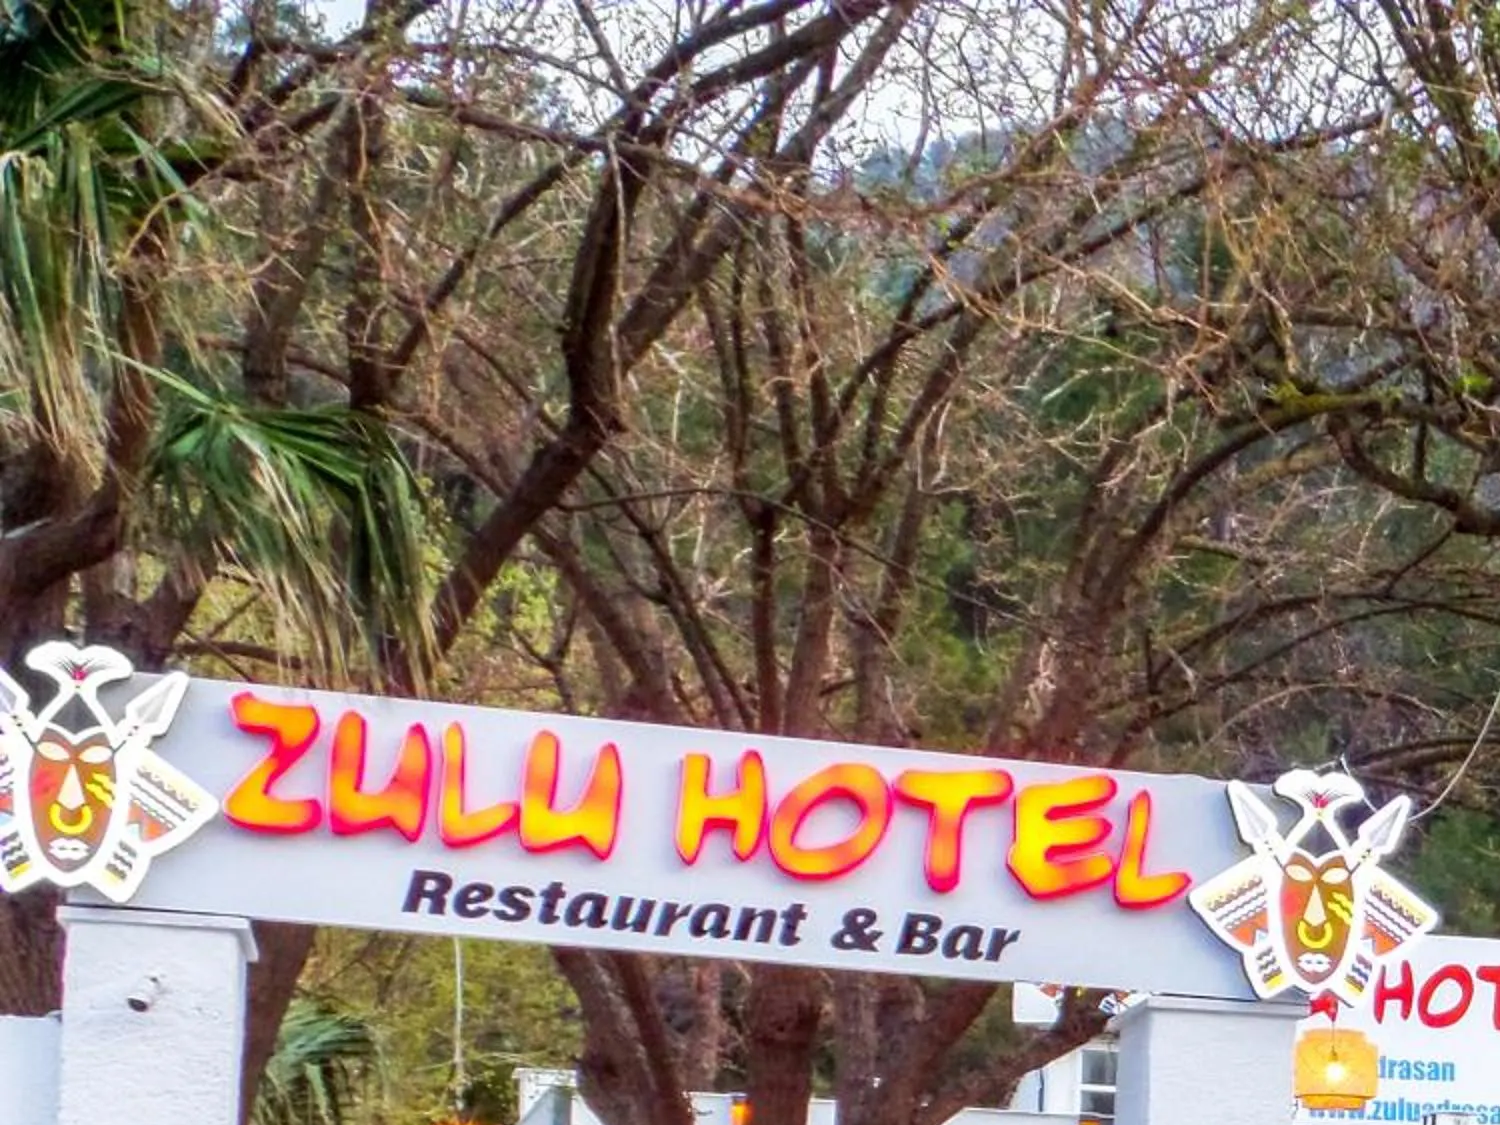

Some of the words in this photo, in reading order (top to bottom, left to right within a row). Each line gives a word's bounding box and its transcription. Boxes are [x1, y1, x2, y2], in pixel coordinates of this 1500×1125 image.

[223, 691, 624, 861] ZULU
[675, 749, 1192, 909] HOTEL
[402, 869, 807, 947] Restaurant
[831, 908, 884, 952] &
[896, 912, 1021, 963] Bar
[1377, 1055, 1456, 1082] drasan
